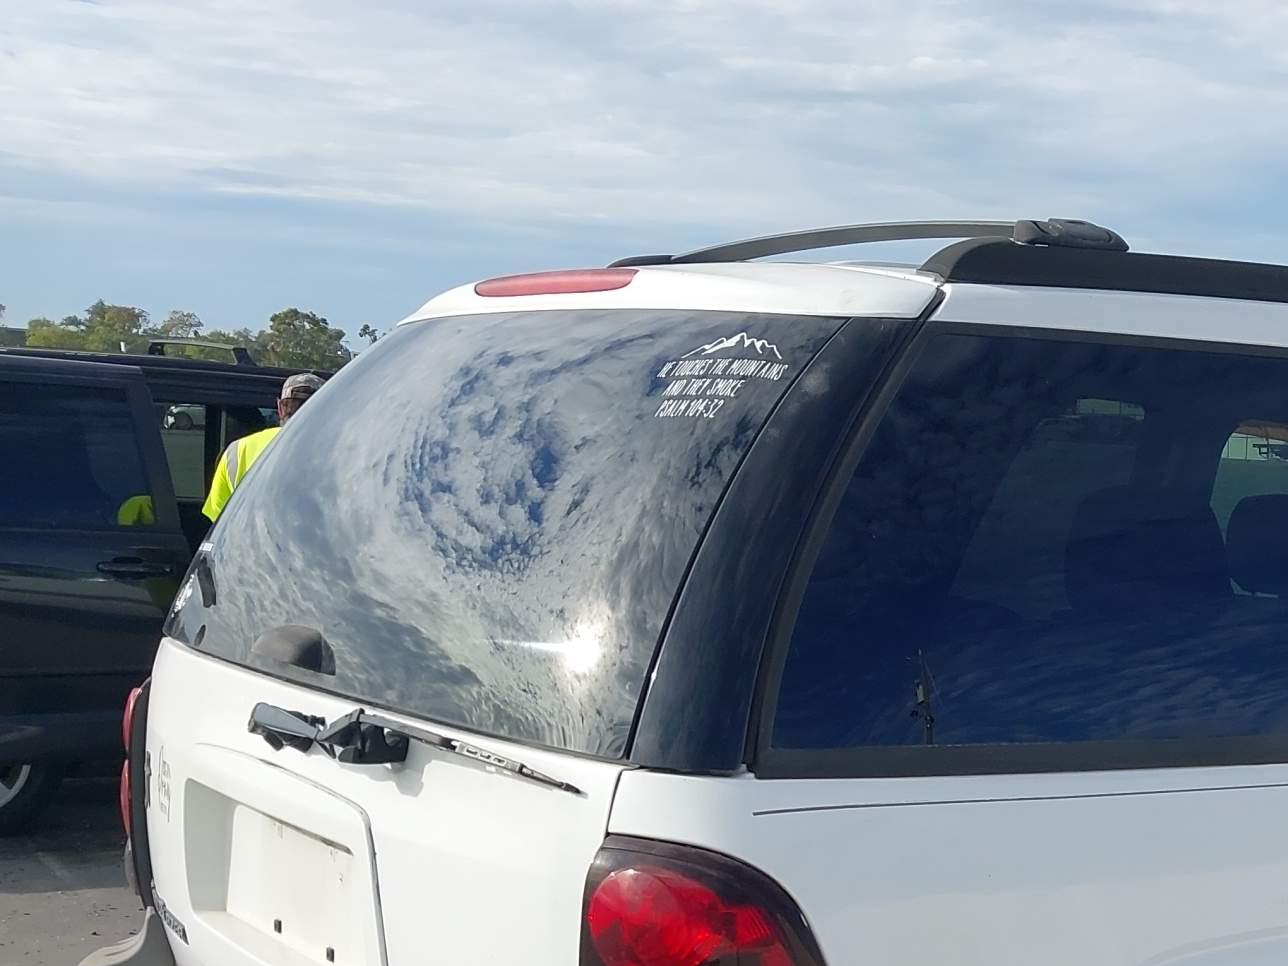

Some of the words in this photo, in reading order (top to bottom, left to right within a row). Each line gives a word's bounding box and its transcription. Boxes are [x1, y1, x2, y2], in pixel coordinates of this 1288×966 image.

[656, 361, 677, 378] HE
[670, 358, 714, 377] TOUCHES
[708, 358, 733, 376] THE
[726, 358, 789, 381] MOUNTAINS
[662, 379, 687, 397] AND
[682, 378, 713, 396] THEY
[706, 378, 747, 398] SMOKE
[654, 399, 690, 418] PSALM
[685, 398, 725, 419] 104:32
